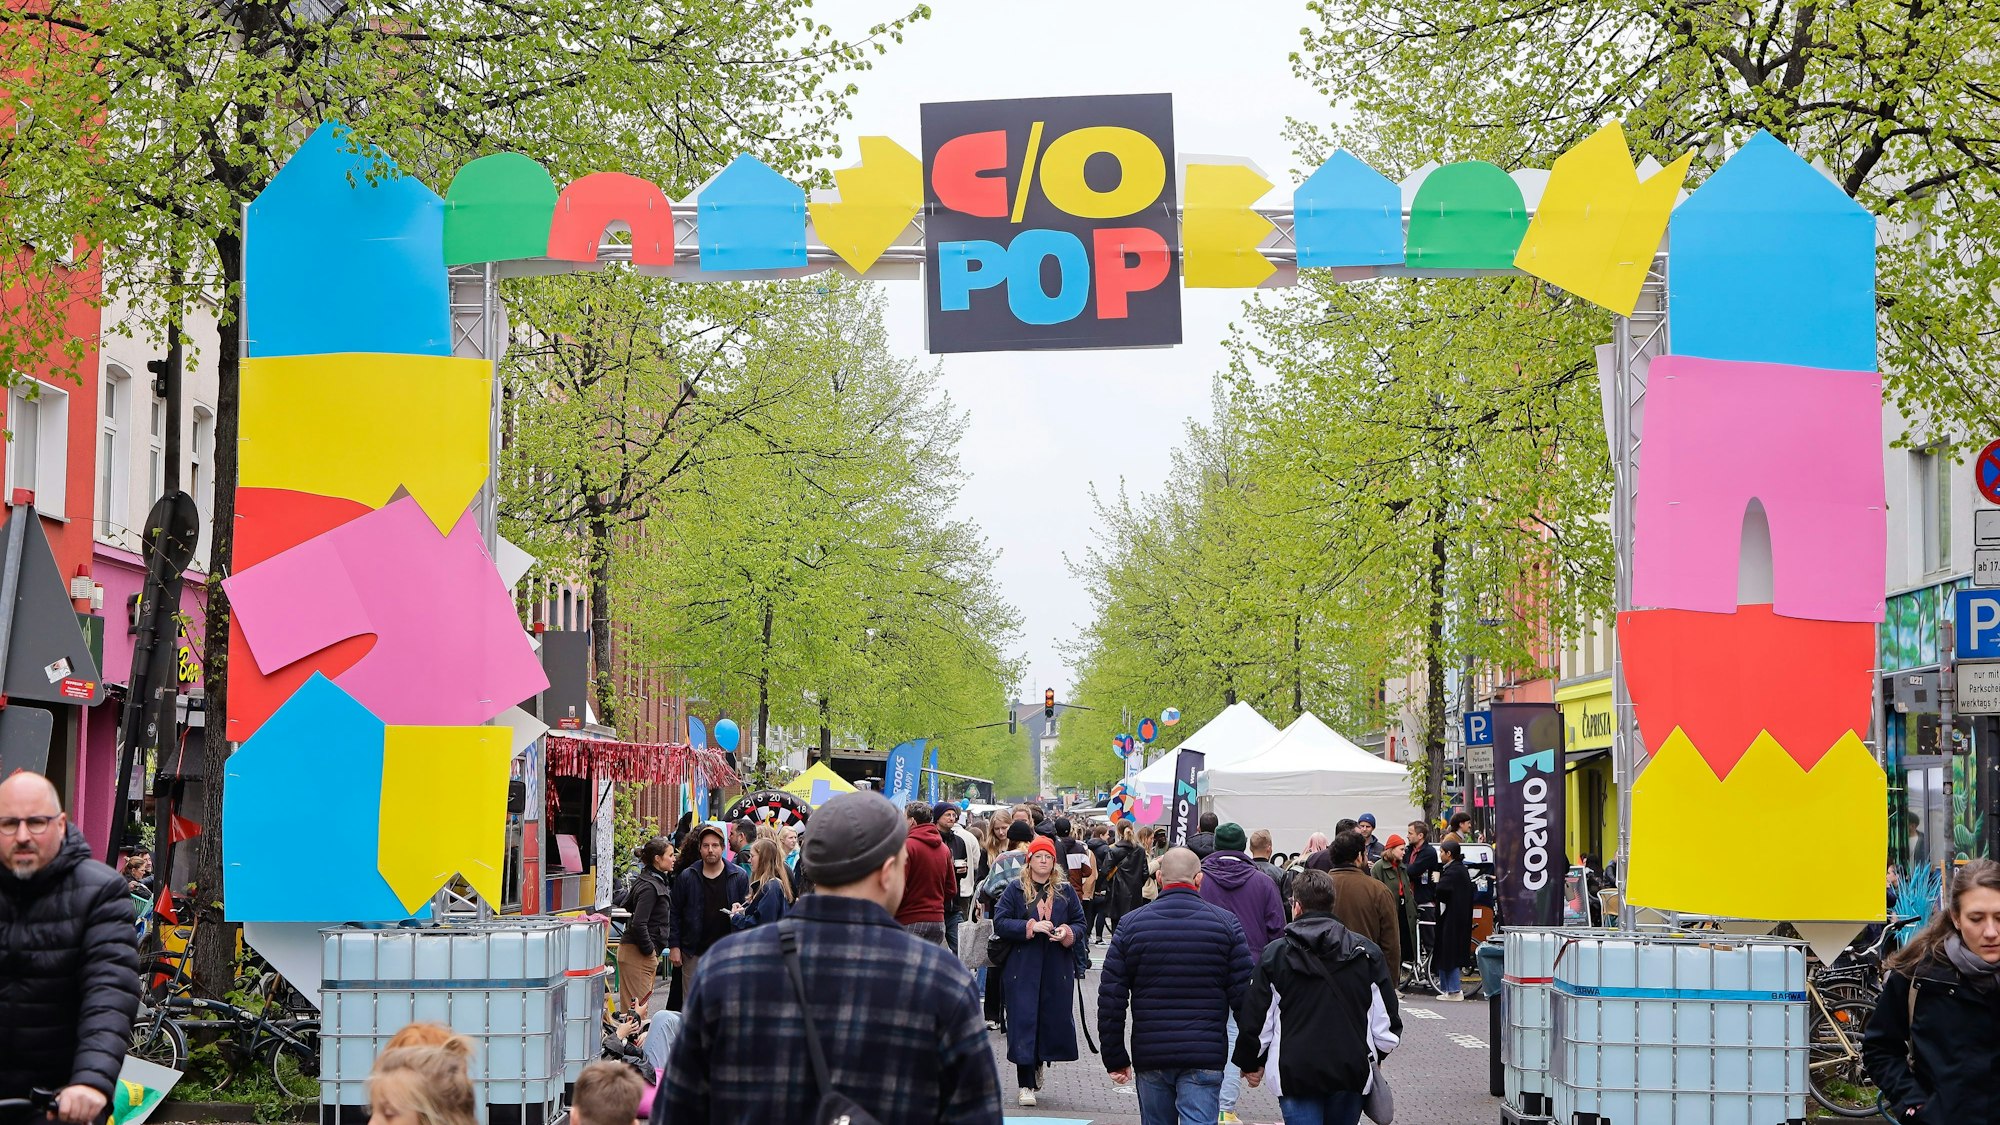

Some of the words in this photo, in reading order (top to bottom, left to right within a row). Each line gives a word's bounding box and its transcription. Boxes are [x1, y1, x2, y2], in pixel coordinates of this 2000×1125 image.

[931, 121, 1167, 224] C/O
[938, 227, 1171, 325] POP
[1978, 562, 1988, 572] ab
[1970, 598, 2000, 650] P
[1974, 671, 1986, 680] nur
[1960, 699, 1991, 710] werktags
[1470, 715, 1487, 742] P
[732, 808, 739, 818] 9
[741, 799, 752, 808] 12
[757, 793, 764, 802] 5
[769, 793, 781, 802] 20
